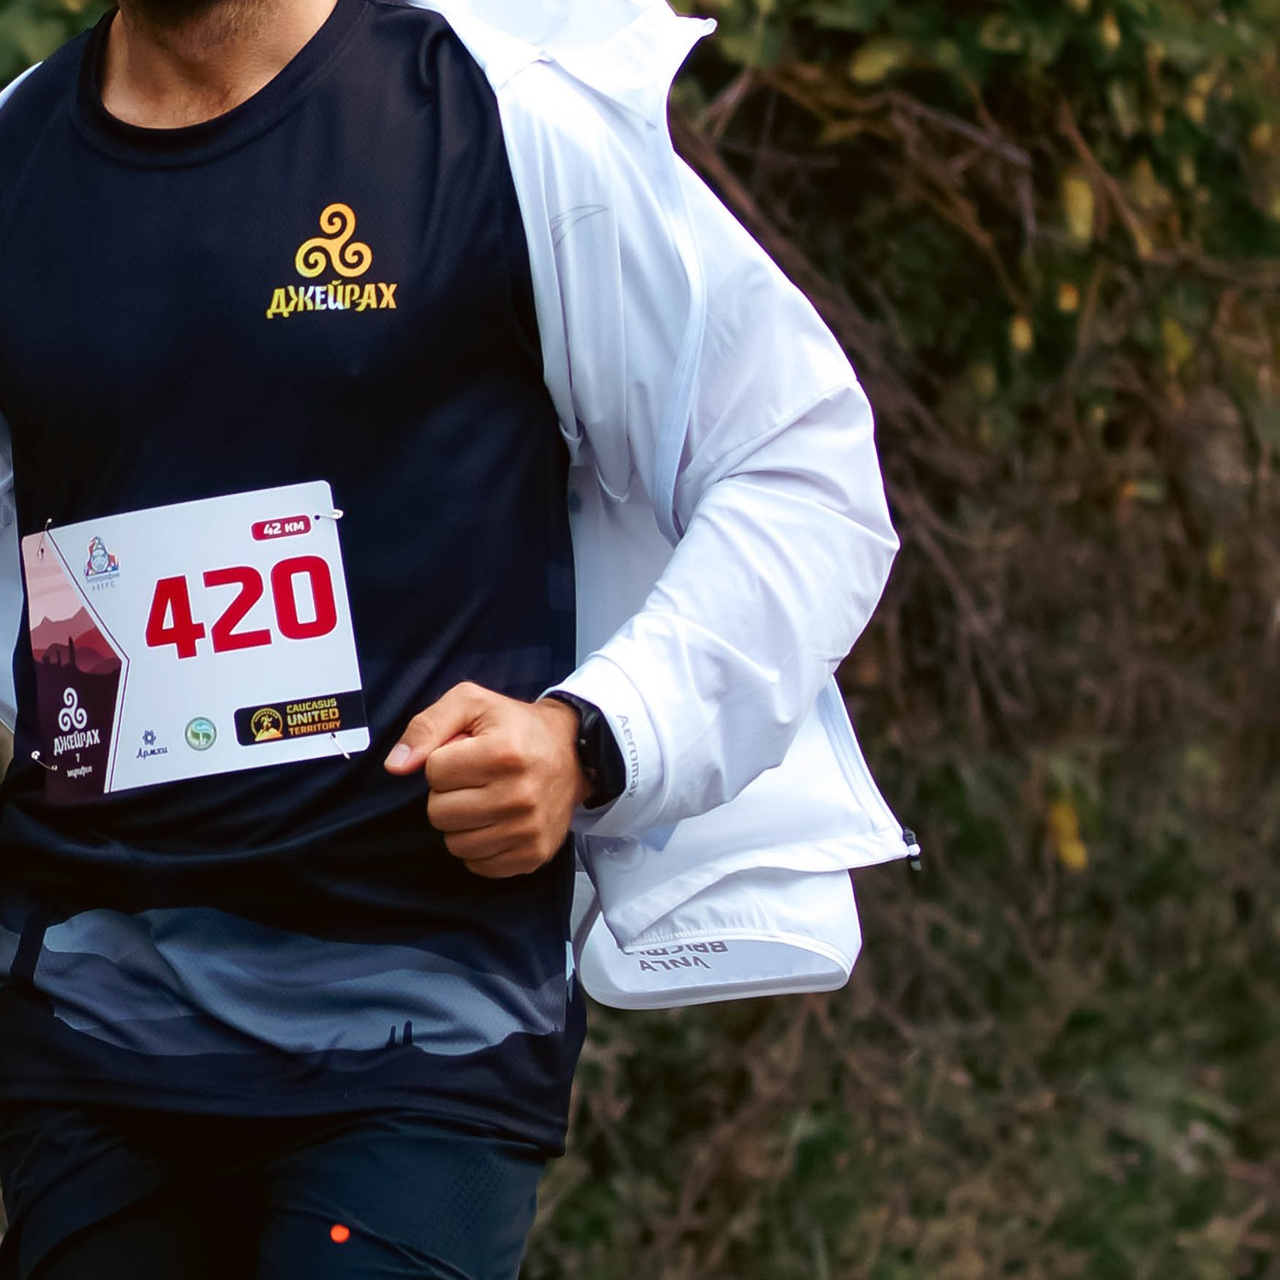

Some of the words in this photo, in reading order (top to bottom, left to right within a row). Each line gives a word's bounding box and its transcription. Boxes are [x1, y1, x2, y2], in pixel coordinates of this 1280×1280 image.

[266, 280, 397, 319] ДЖЕЙРАХ
[263, 522, 282, 535] 42
[146, 555, 337, 659] 420
[286, 697, 337, 714] CAUCASUS
[287, 707, 340, 726] UNITED
[288, 720, 341, 736] TERRITORY
[53, 728, 100, 756] ДЖЕЙРАХ
[136, 746, 168, 759] Армхи
[616, 714, 640, 798] Aeromax
